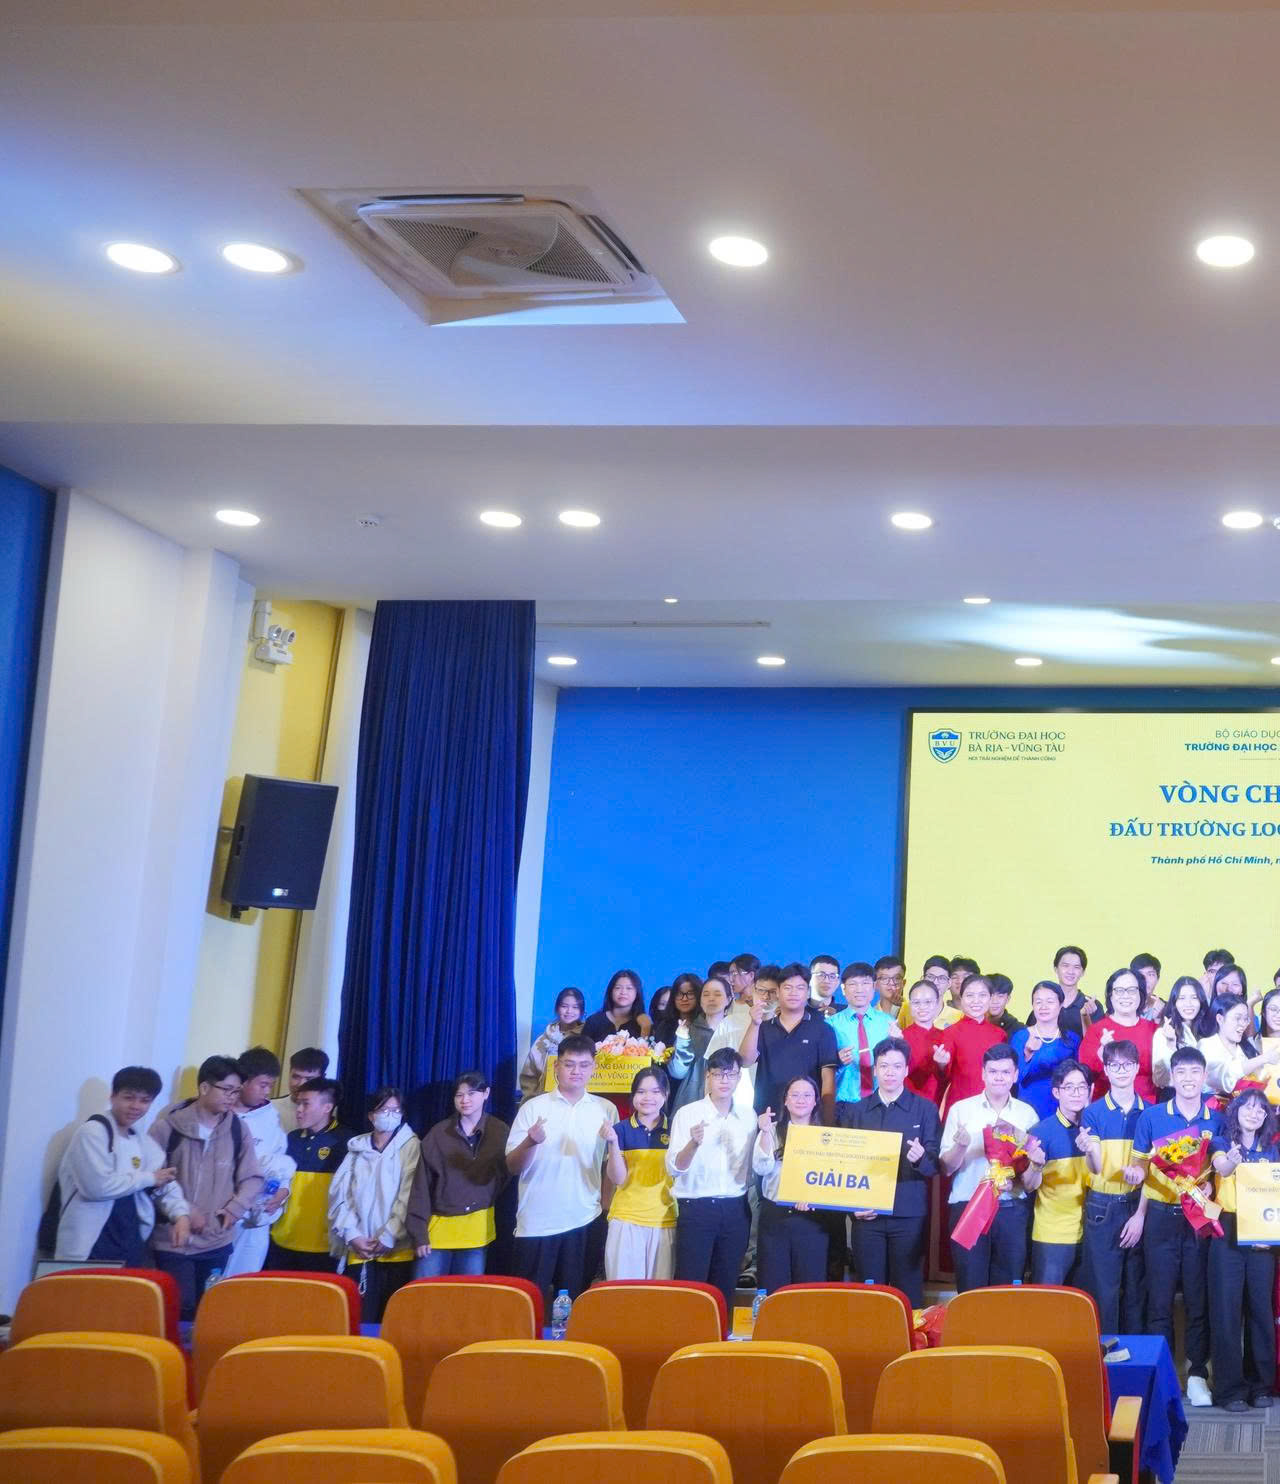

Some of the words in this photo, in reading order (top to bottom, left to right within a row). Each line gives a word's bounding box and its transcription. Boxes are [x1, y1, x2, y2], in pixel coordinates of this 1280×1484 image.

[968, 730, 1016, 740] TRƯỜNG
[1019, 731, 1040, 742] ĐẠI
[1041, 731, 1066, 742] HỌC
[1215, 728, 1230, 740] BỘ
[1233, 729, 1258, 738] GIÁO
[968, 743, 983, 752] BÀ
[985, 743, 1003, 754] RỊA
[1012, 742, 1042, 752] VŨNG
[1044, 742, 1066, 752] TÀU
[1185, 741, 1230, 751] TRƯỜNG
[1232, 743, 1252, 753] ĐẠI
[1254, 743, 1278, 753] HỌC
[1160, 780, 1240, 803] VÒNG
[1109, 817, 1152, 837] ĐẤU
[1157, 818, 1246, 837] TRƯỜNG
[1151, 855, 1183, 865] Thành
[1185, 855, 1206, 868] phố
[1208, 855, 1222, 865] Hồ
[1224, 855, 1243, 865] Chí
[1244, 856, 1274, 867] Minh,
[806, 1168, 843, 1187] GIẢI
[846, 1174, 870, 1190] BA
